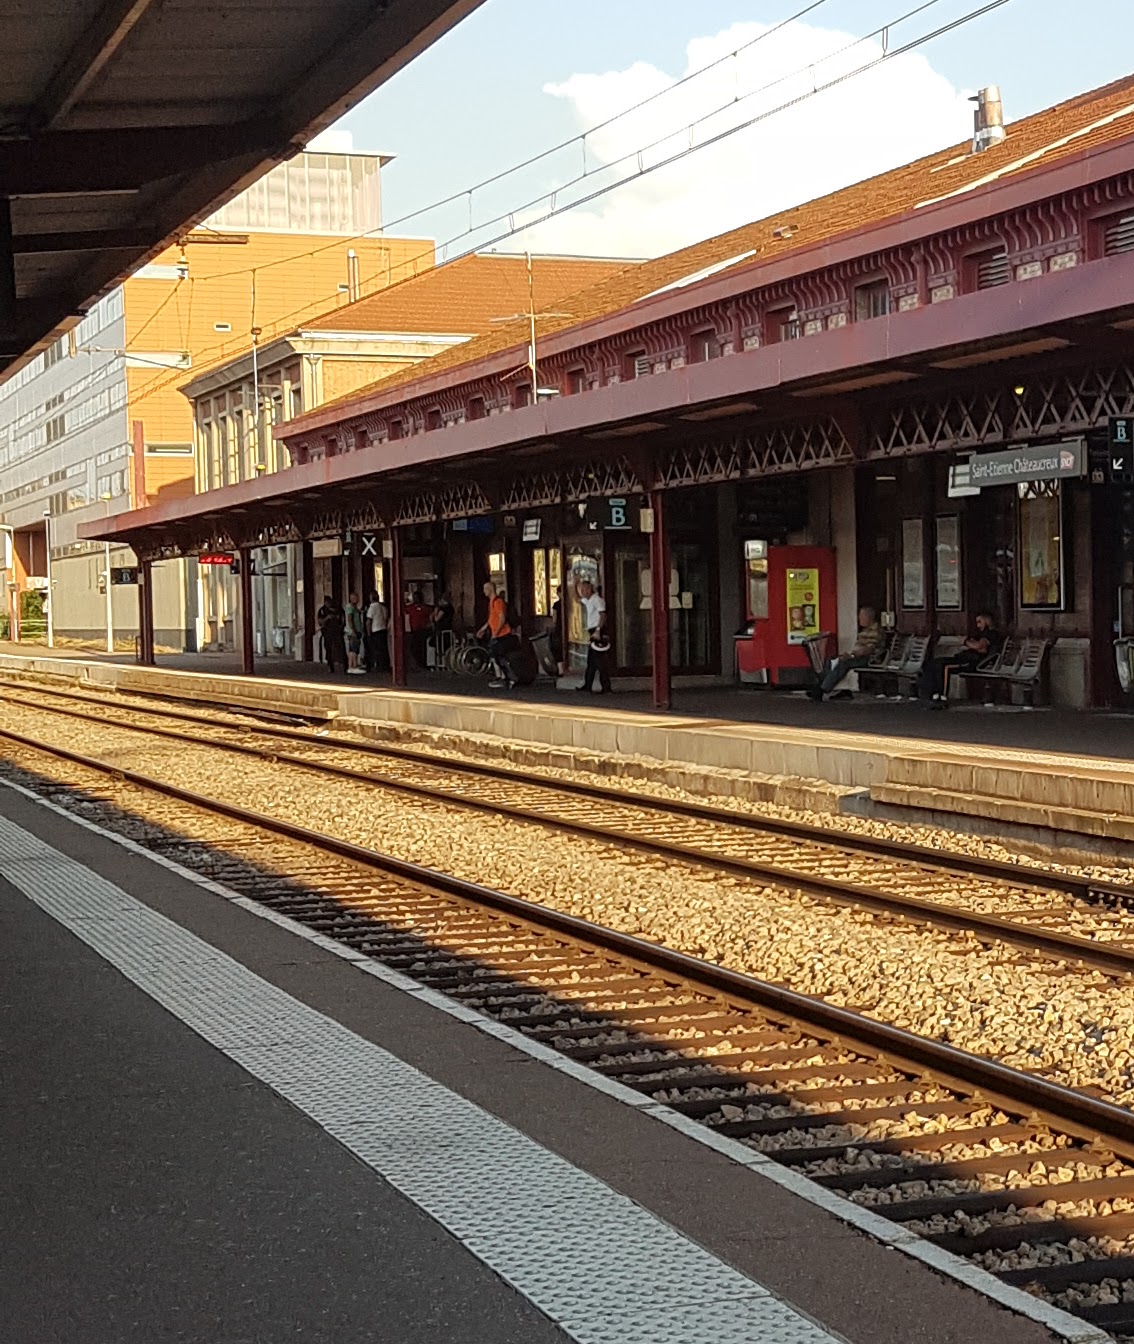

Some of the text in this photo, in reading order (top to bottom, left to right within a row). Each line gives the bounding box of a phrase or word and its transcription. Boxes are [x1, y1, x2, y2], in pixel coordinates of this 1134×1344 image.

[1117, 426, 1127, 440] B
[611, 506, 626, 526] B
[361, 536, 377, 556] X
